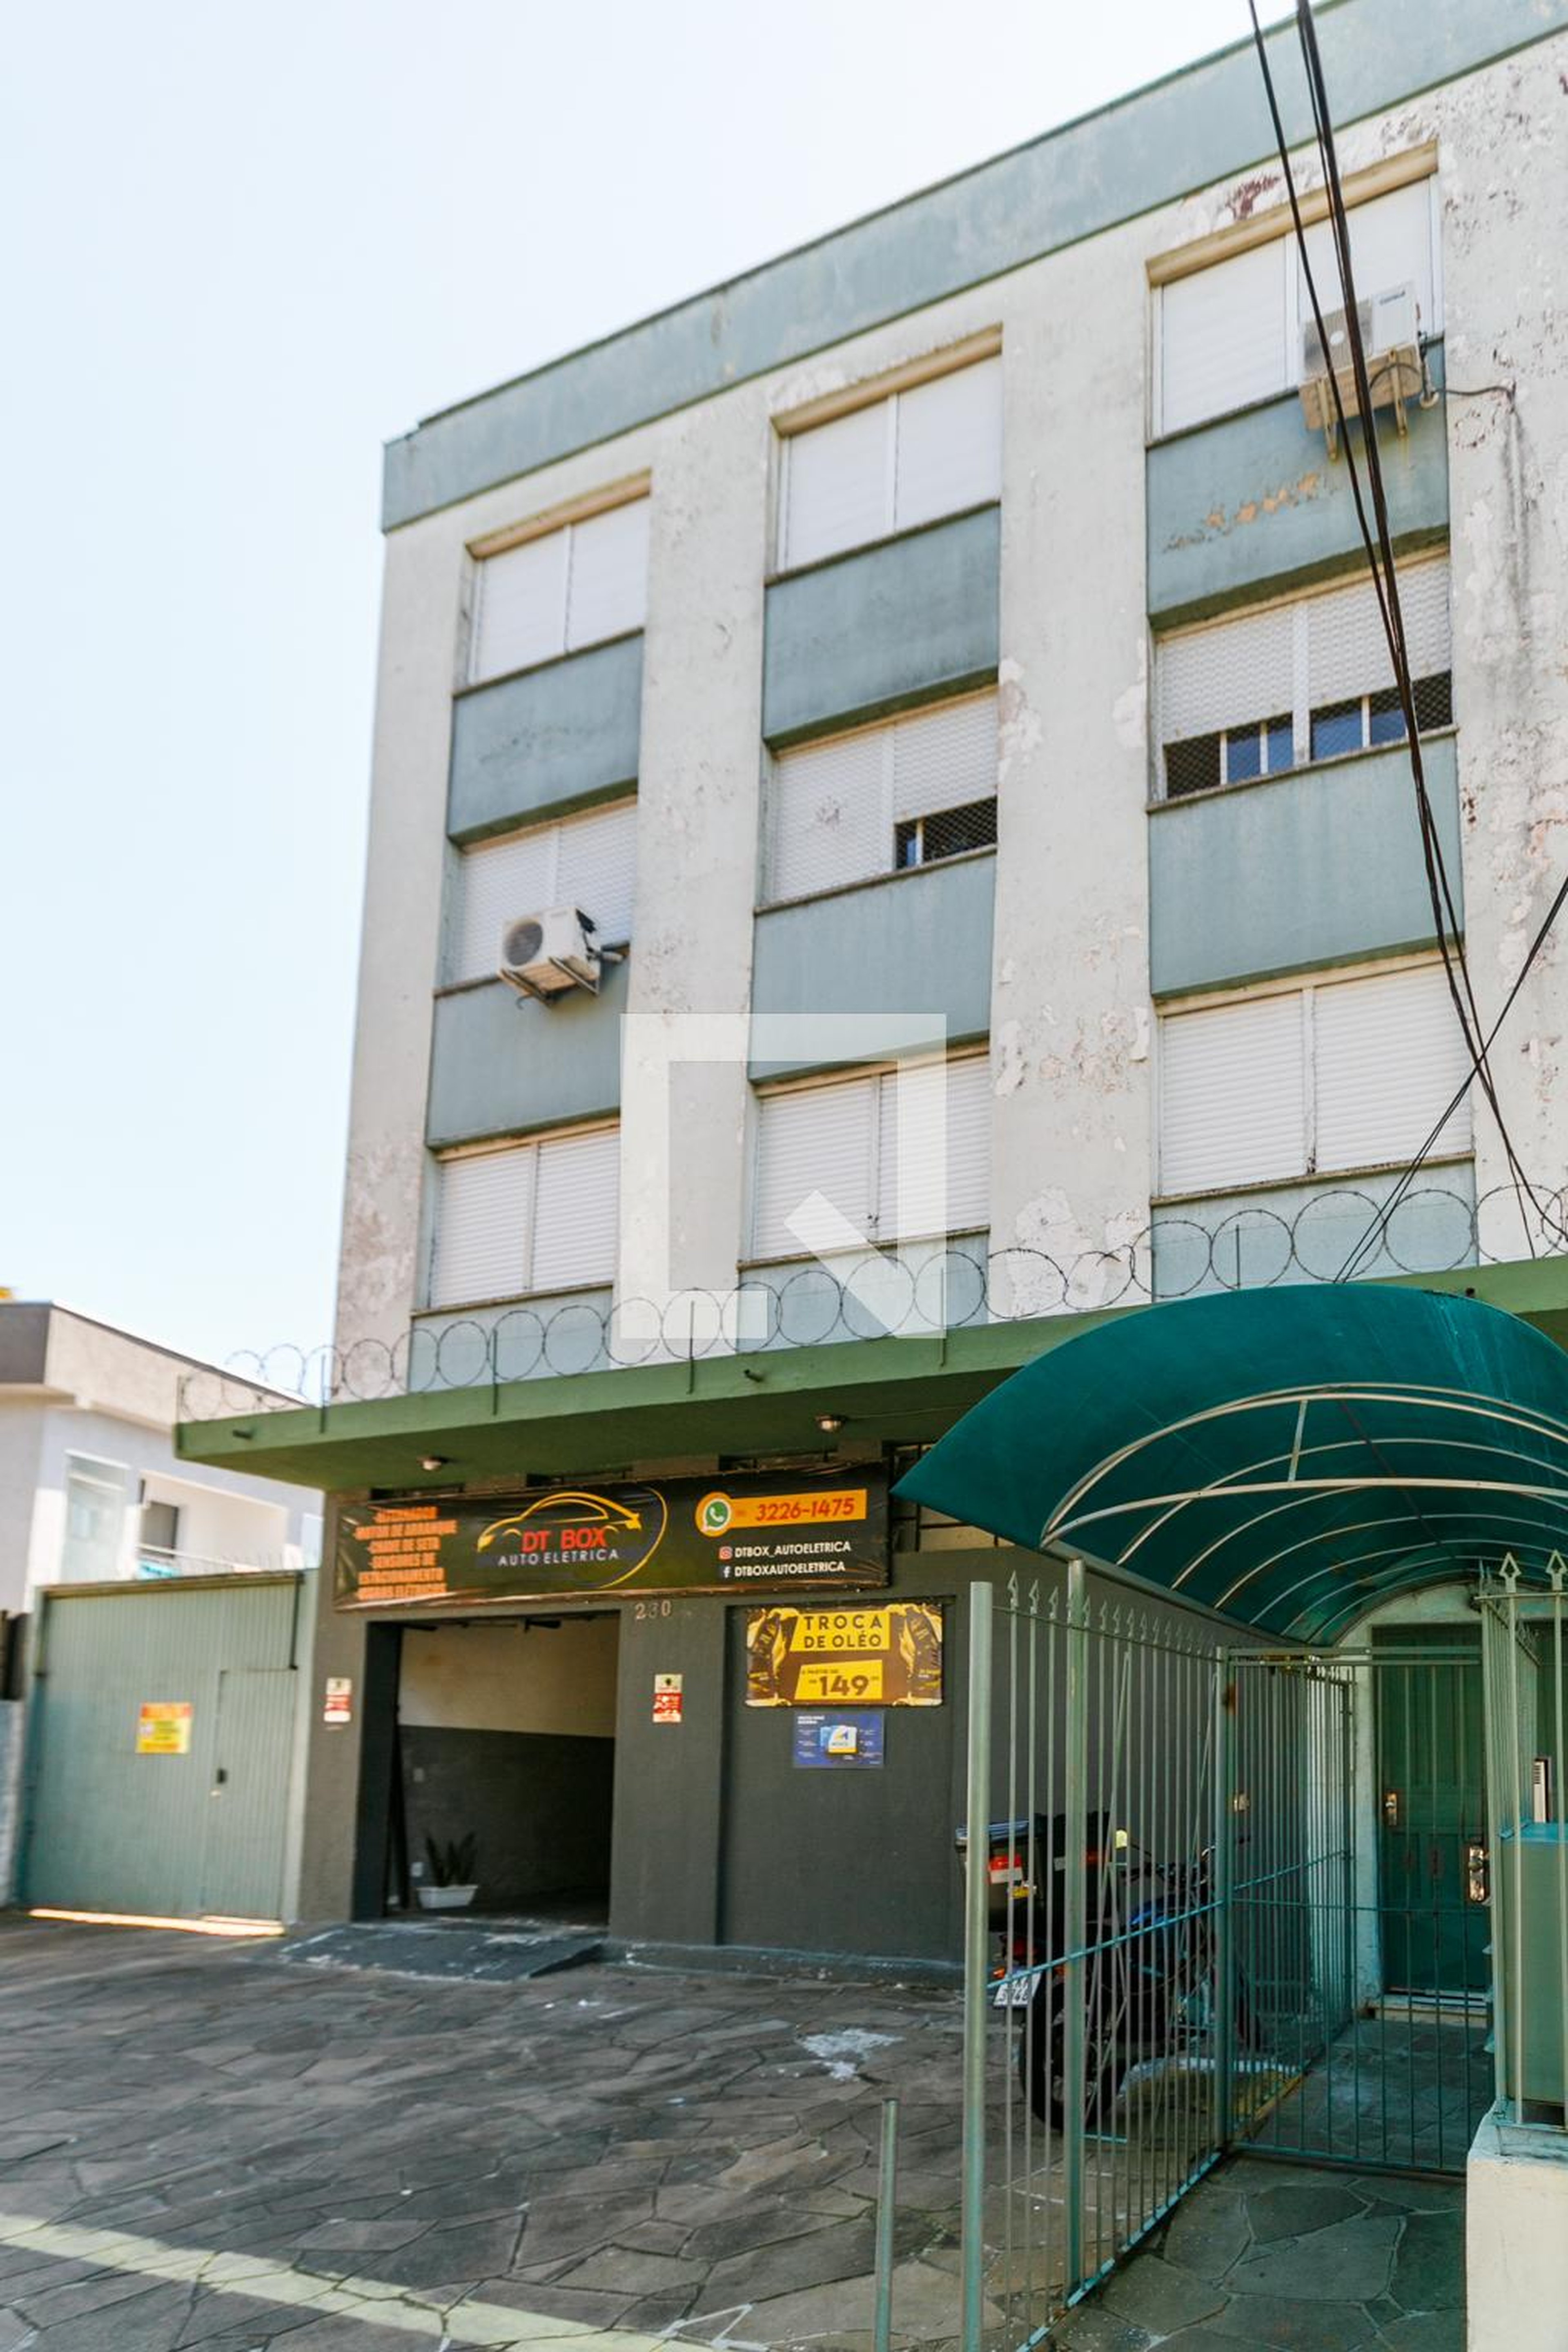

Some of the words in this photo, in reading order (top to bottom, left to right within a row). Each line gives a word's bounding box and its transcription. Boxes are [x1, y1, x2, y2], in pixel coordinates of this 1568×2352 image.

[757, 1498, 854, 1521] 3226-1475
[522, 1530, 548, 1552] DT
[560, 1528, 607, 1550] BOX
[498, 1553, 539, 1566] AUTO
[543, 1549, 619, 1564] ELETRICA
[804, 1615, 882, 1630] TROCA
[804, 1636, 826, 1648] DE
[833, 1630, 881, 1648] OLÉO
[820, 1675, 869, 1696] 149
